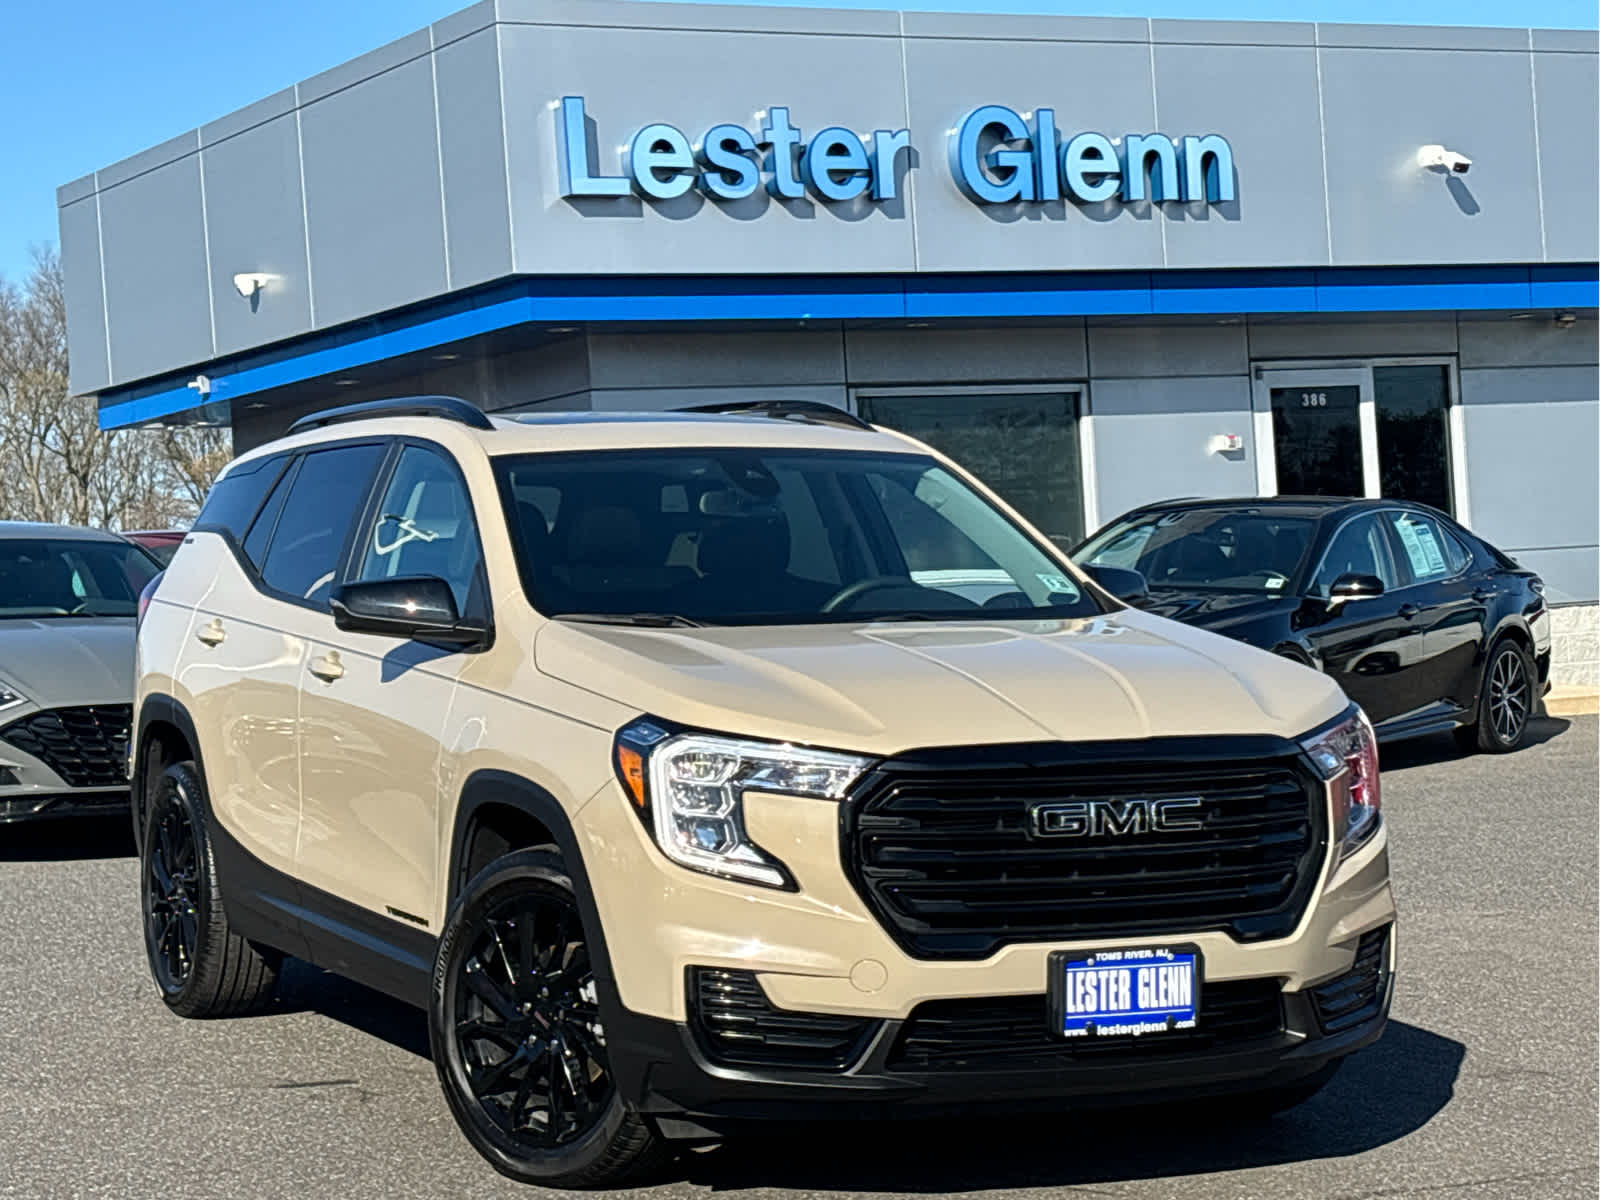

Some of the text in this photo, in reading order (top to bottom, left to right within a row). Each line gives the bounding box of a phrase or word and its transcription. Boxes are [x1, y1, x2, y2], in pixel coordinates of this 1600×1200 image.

[559, 96, 1234, 204] Lester Glenn
[1302, 393, 1327, 407] 386
[1032, 797, 1203, 837] GMC
[1096, 952, 1122, 961] TOMS
[1066, 965, 1192, 1013] LESTER GLENN
[1096, 1021, 1168, 1036] lesterglenn
